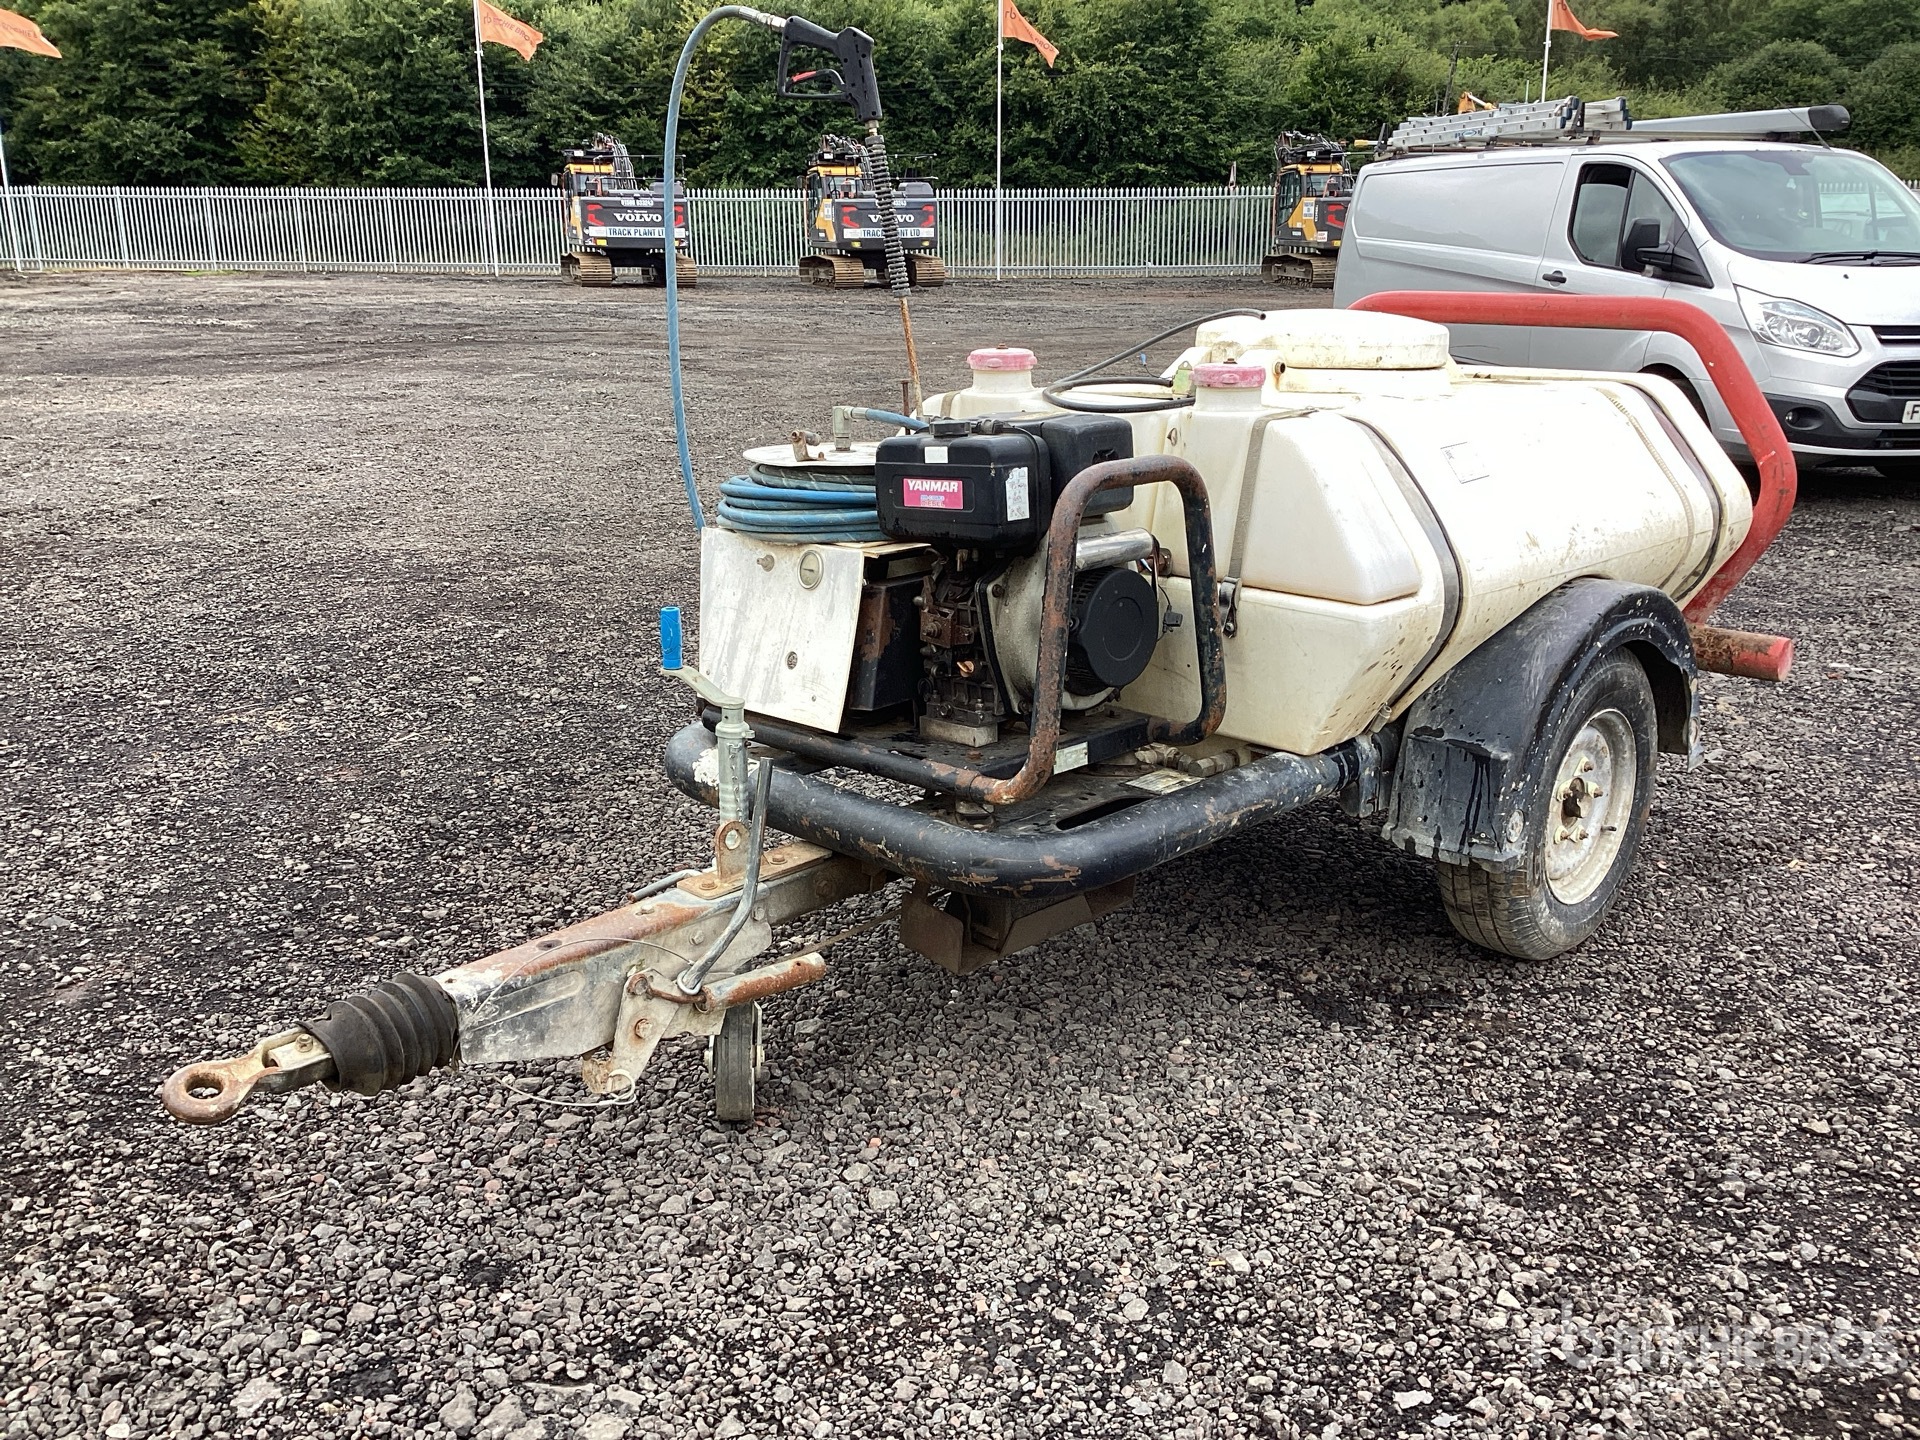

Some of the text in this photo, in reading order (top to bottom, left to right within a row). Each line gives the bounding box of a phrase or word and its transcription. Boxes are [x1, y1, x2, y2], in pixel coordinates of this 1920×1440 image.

[613, 212, 662, 222] VOLVO
[868, 214, 914, 223] VVO
[608, 227, 632, 236] TRACK
[634, 228, 656, 237] PLANT
[863, 229, 884, 238] TRAC
[910, 229, 921, 237] LTD
[907, 479, 958, 493] YANMAR
